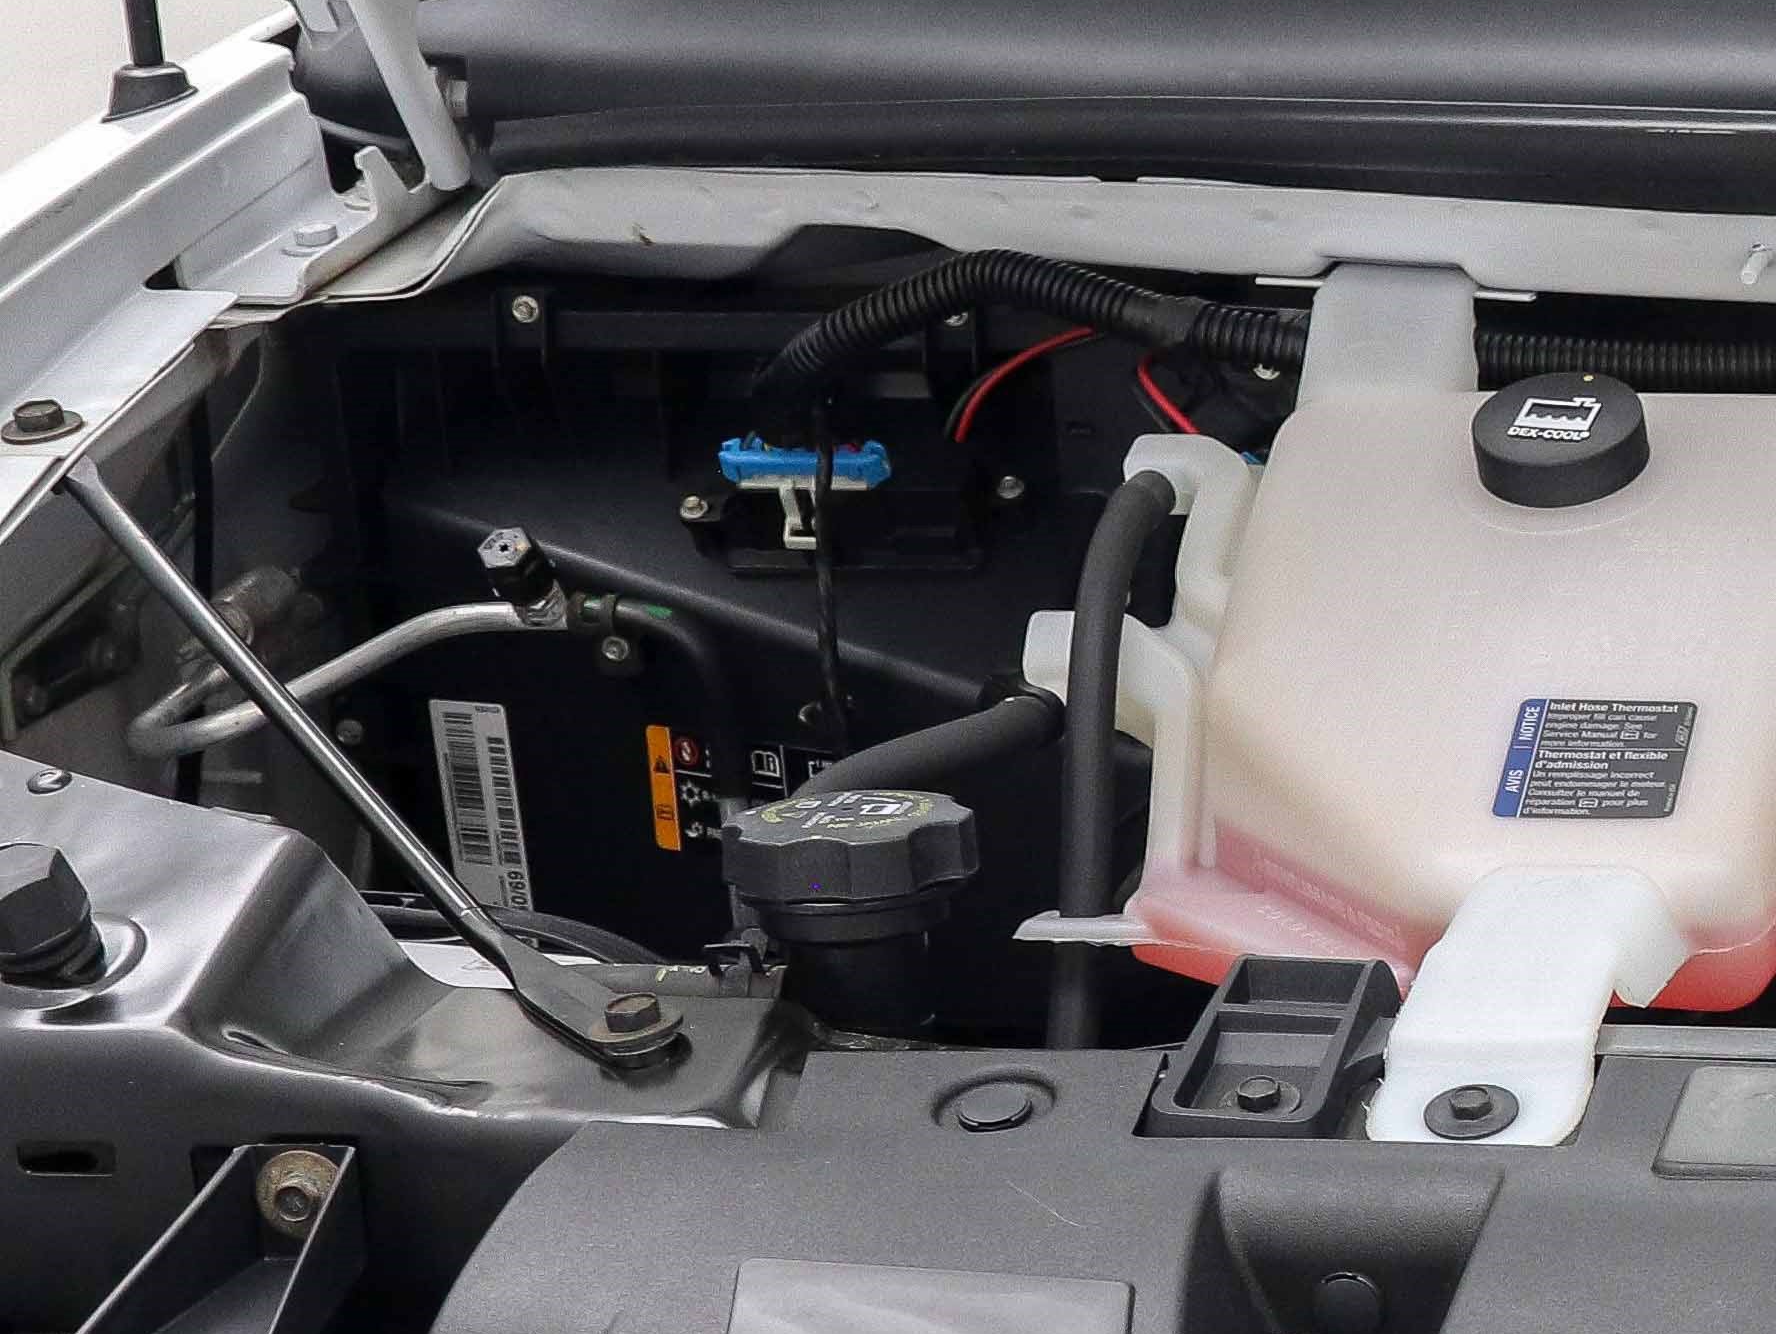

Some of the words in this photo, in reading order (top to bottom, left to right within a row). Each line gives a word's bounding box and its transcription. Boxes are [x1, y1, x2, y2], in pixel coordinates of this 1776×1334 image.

[1550, 702, 1577, 711] Inlet
[1579, 702, 1608, 711] Hose
[1612, 703, 1678, 712] Thermostat
[1518, 706, 1540, 741] NOTICE
[1539, 750, 1607, 759] Thermostat
[1609, 751, 1621, 759] et
[1624, 751, 1668, 760] flexible
[1504, 769, 1524, 793] AVIS
